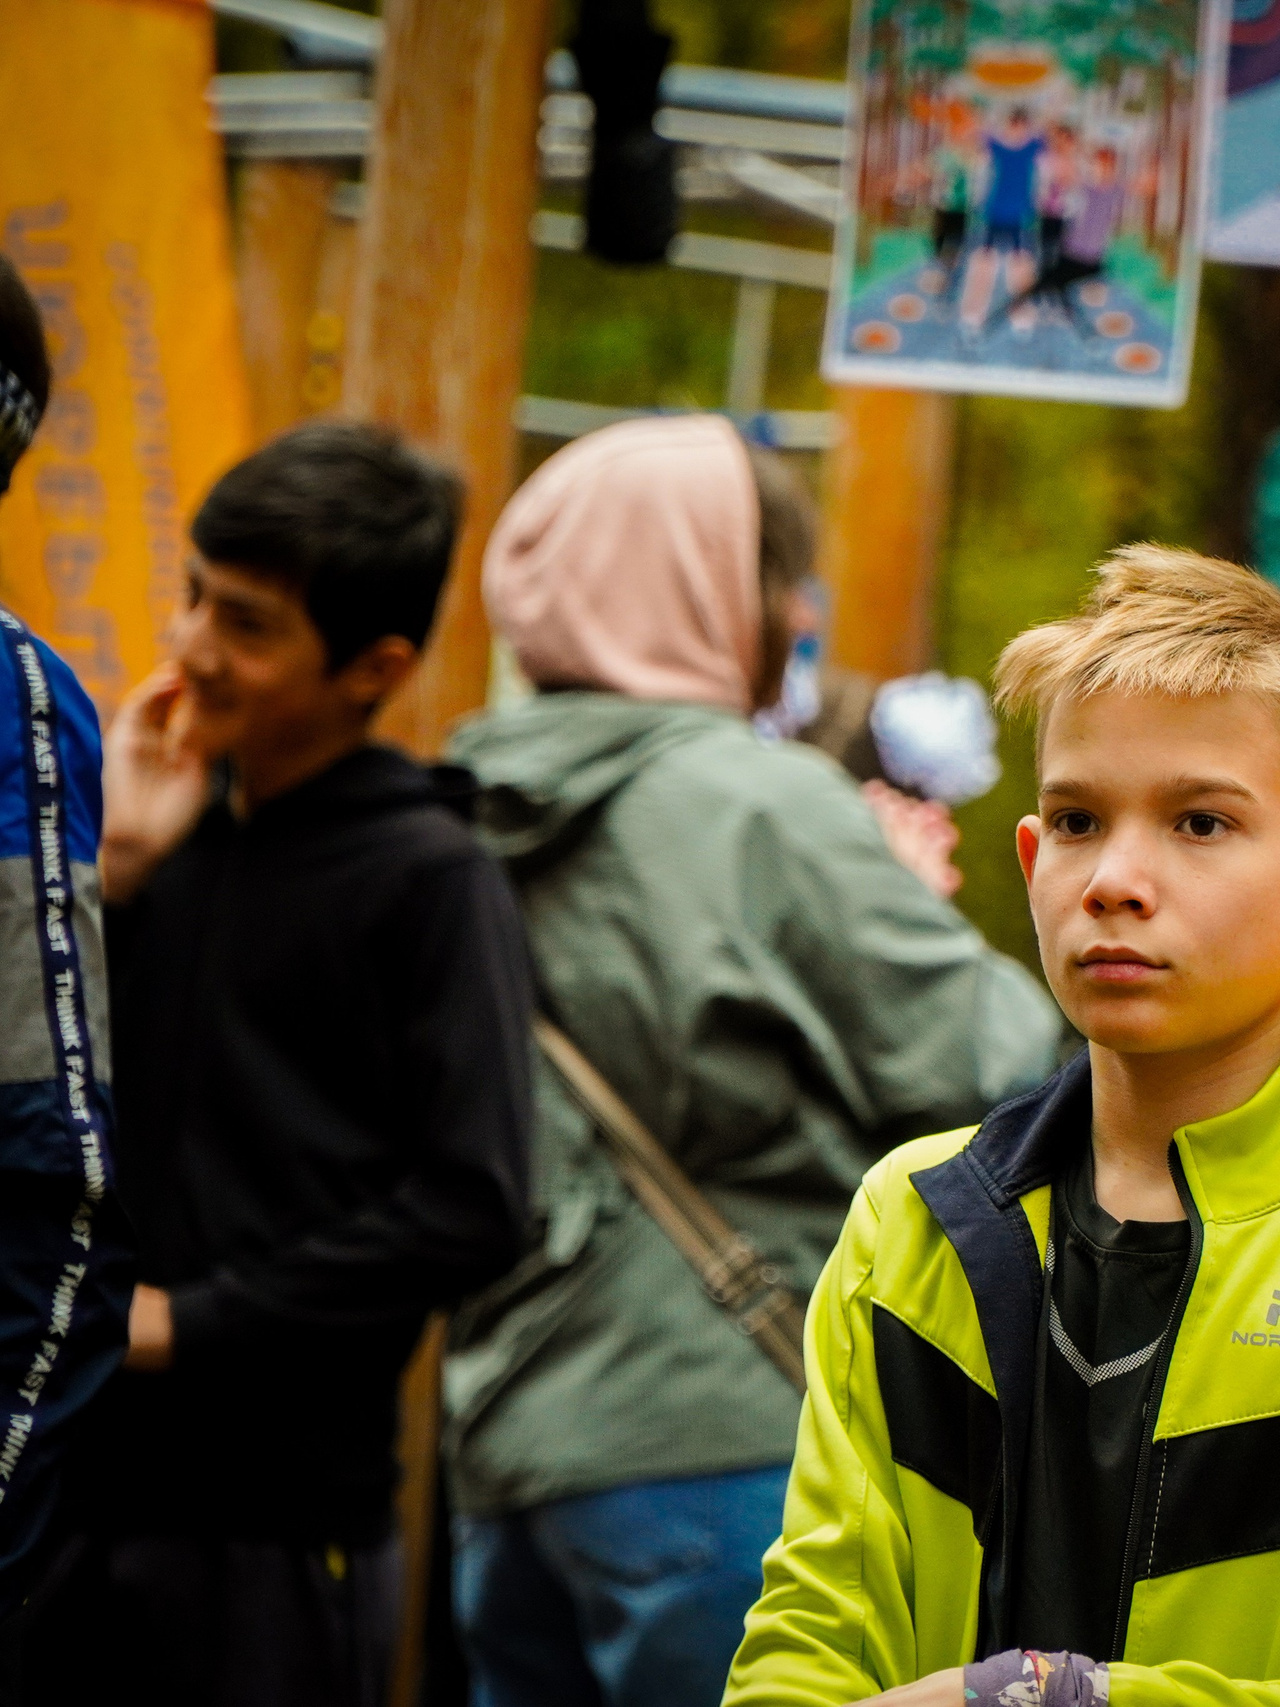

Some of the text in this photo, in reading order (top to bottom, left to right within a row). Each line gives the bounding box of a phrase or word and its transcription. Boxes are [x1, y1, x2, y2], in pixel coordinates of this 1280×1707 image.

[16, 641, 58, 789] THINK FAST
[38, 800, 71, 957] THINK FAST
[54, 967, 92, 1124] THINK FAST
[70, 1201, 93, 1252] AST
[17, 1263, 87, 1407] THINK FAST
[0, 1412, 34, 1483] THINK
